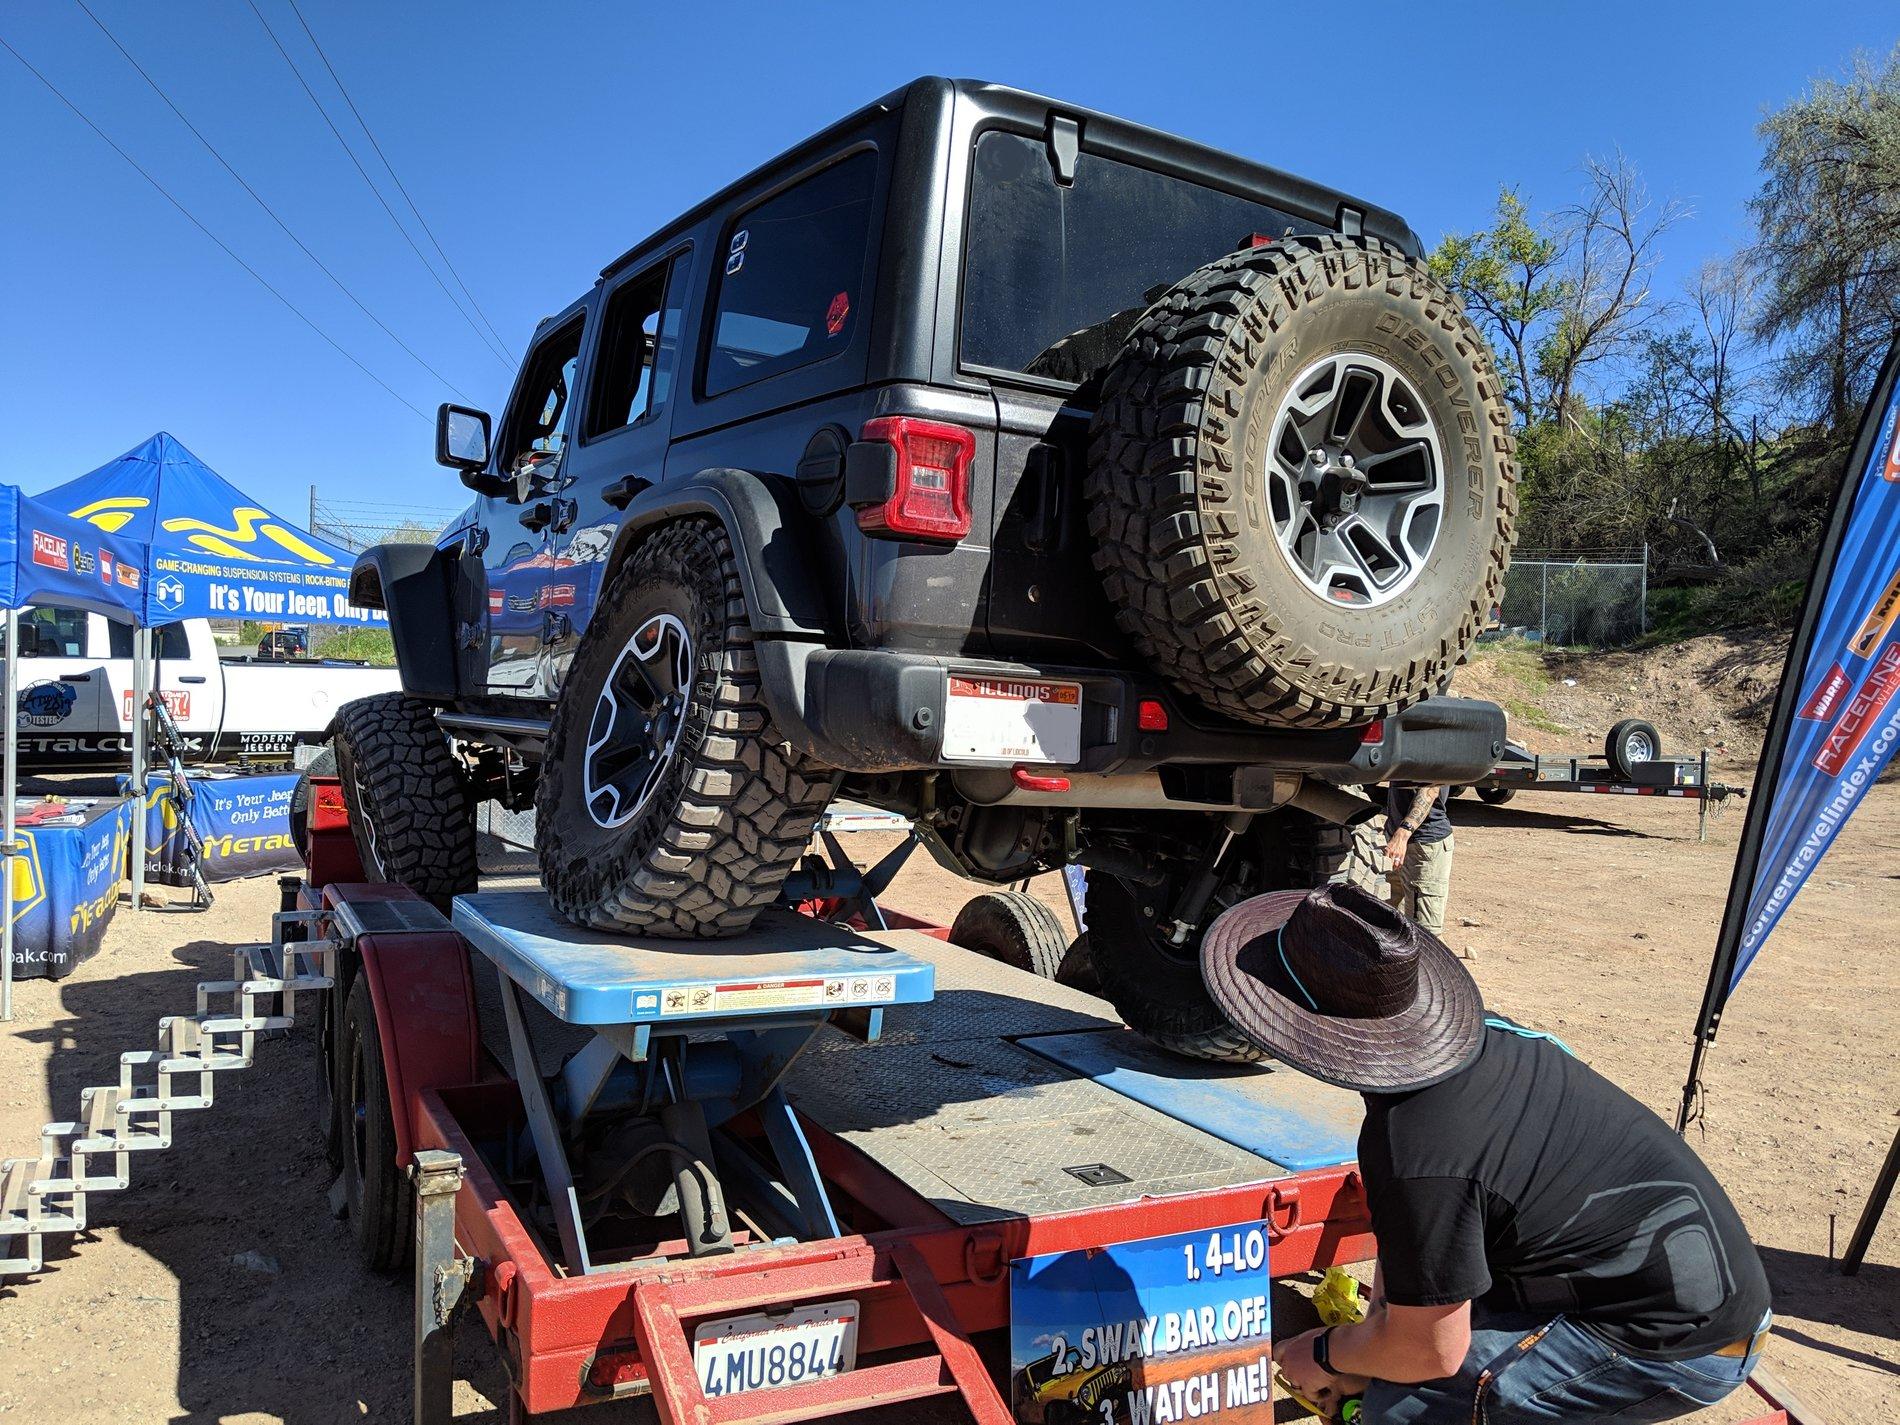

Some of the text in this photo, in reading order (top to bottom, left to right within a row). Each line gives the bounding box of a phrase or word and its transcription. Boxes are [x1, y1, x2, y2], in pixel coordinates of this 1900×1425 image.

[1243, 336, 1298, 529] COOPER
[1375, 312, 1486, 521] DISCOVERER
[156, 558, 222, 577] GAME-CHANGING
[222, 566, 269, 581] SUSPENSION
[269, 572, 301, 585] SYSTEMS
[305, 574, 347, 588] ROCK-BITING
[209, 583, 240, 611] It's
[242, 586, 284, 615] Your
[287, 589, 331, 620] Jeep,
[979, 681, 1051, 700] ILLINOIS
[1813, 674, 1845, 718] WARN
[1815, 646, 1899, 770] RACELINE
[240, 734, 294, 744] MODERN
[243, 743, 289, 753] JEEPER
[215, 797, 233, 812] It's
[236, 793, 264, 807] Your
[231, 808, 261, 825] Only
[1184, 1229, 1265, 1280] 1. 4-LO
[721, 1329, 770, 1345] California
[803, 1317, 837, 1329] Trailer
[1051, 1295, 1267, 1376] 2. SWAY BAR OFF
[705, 1335, 845, 1397] 4MU8844
[1127, 1373, 1220, 1425] WATCH
[1226, 1356, 1269, 1410] ME!
